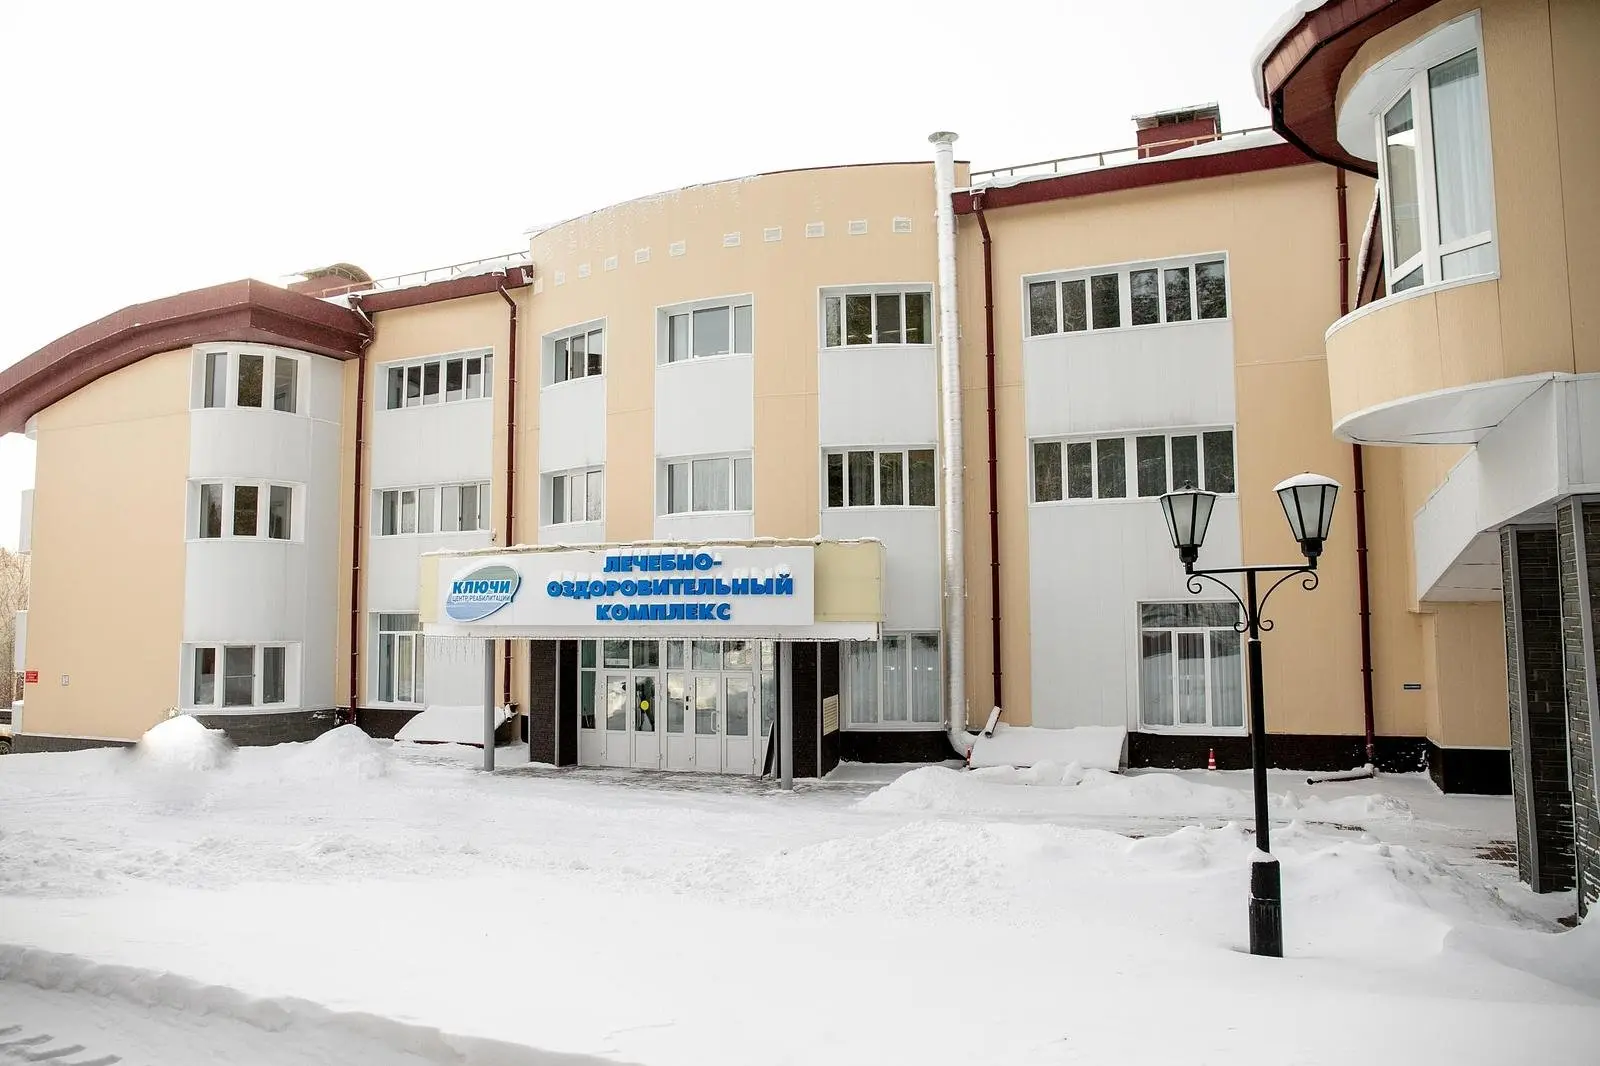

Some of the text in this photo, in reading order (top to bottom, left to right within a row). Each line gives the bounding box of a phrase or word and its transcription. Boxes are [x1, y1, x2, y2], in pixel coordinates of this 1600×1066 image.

[603, 553, 722, 573] ЛЕЧЕБНО-
[452, 580, 511, 594] КЛЮЧИ
[546, 573, 793, 599] ОЗДОРОВИТЕЛЬНЫЙ
[596, 603, 731, 621] КОМПЛЕКС
